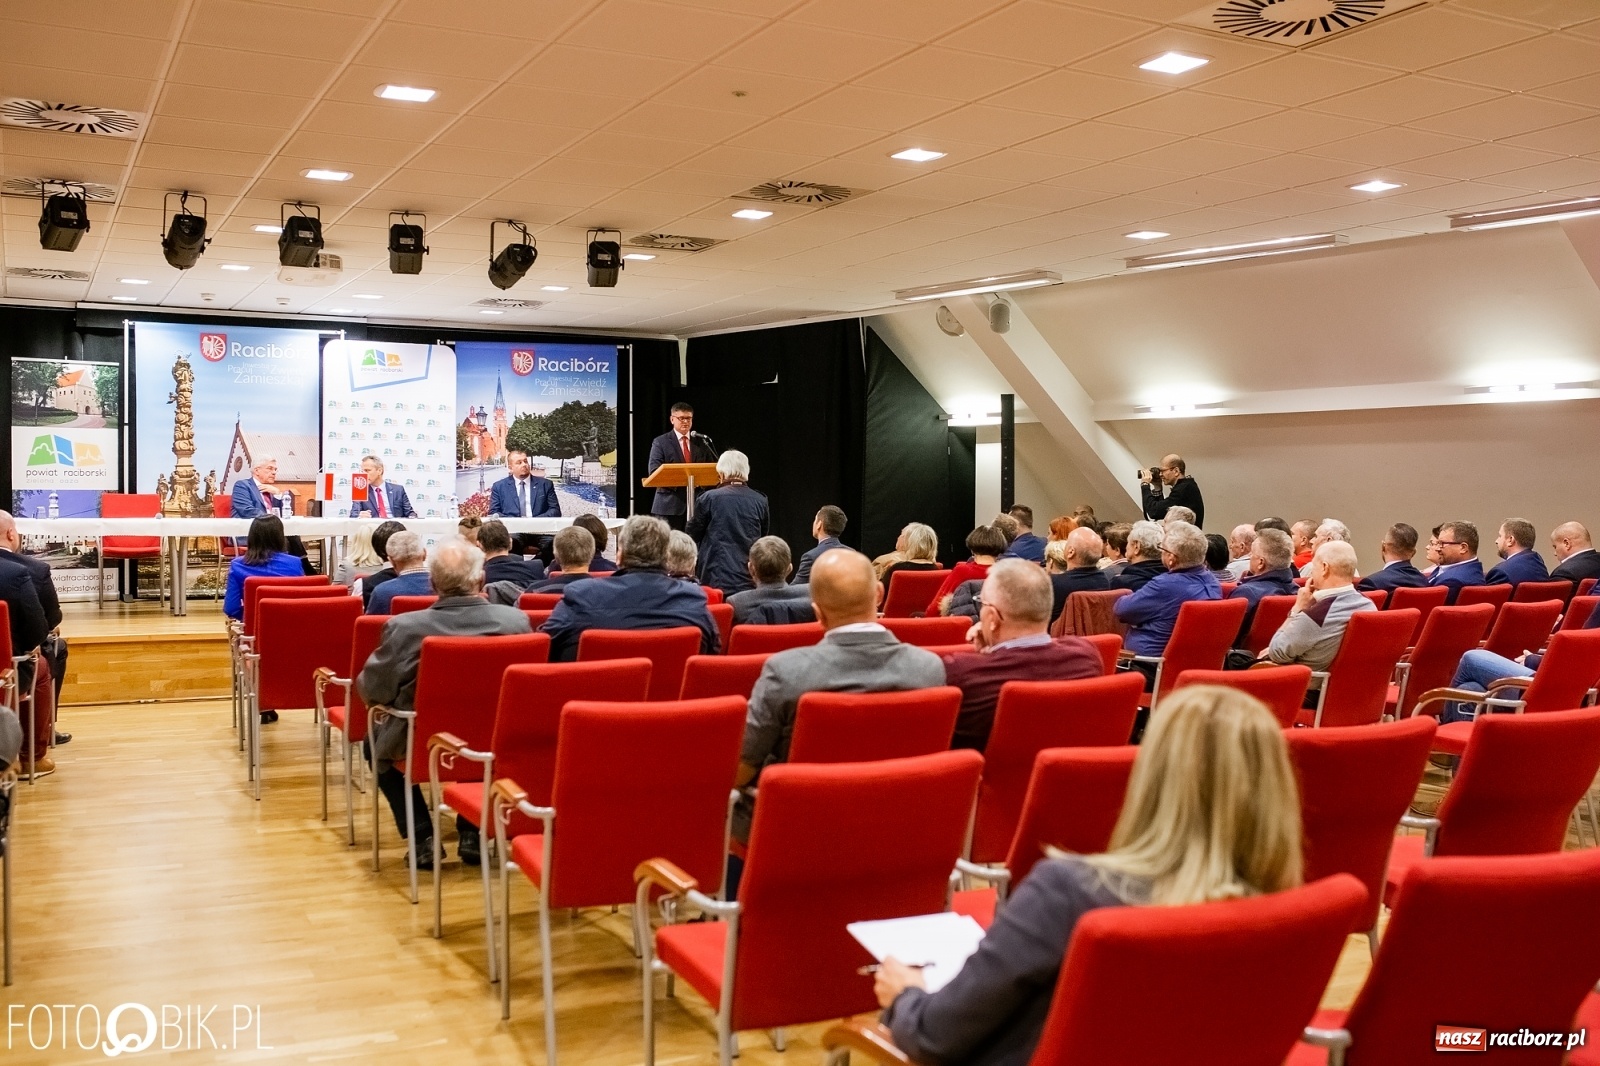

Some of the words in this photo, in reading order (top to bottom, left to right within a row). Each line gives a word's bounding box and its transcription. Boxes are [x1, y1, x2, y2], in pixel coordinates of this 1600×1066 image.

[538, 356, 610, 373] Racibórz
[534, 378, 558, 388] Pracuj
[540, 385, 604, 399] Zamieszkaj
[25, 468, 58, 478] powiat
[63, 468, 107, 477] raciborski
